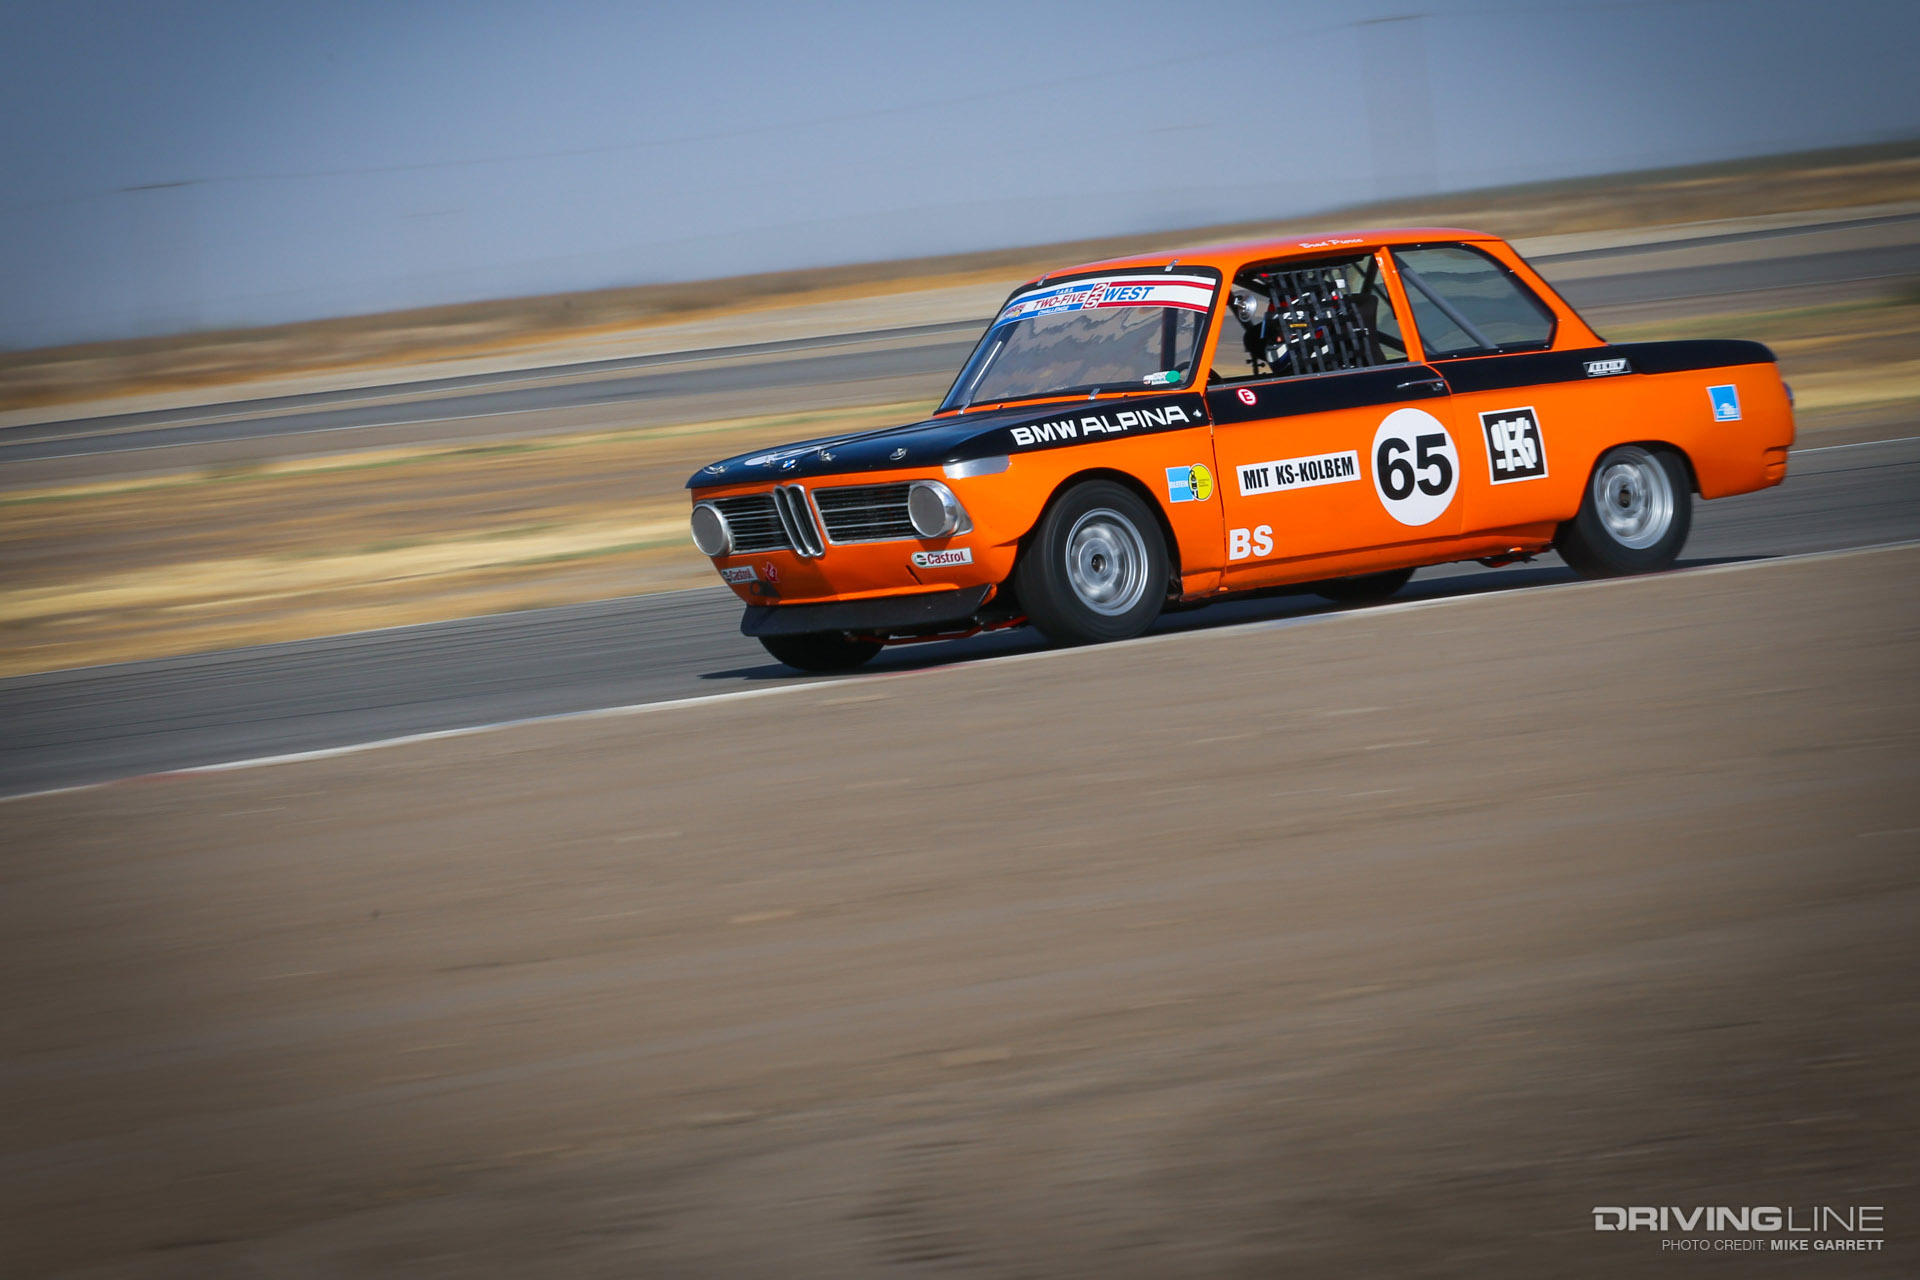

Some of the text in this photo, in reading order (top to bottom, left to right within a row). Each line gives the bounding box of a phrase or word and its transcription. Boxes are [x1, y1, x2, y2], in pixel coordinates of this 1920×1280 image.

[1033, 286, 1155, 310] TWO-FIVE WEST
[1240, 390, 1254, 402] E
[1010, 405, 1190, 446] BMW ALPINA
[1242, 456, 1355, 490] MIT KS-KOLBEM
[1377, 432, 1453, 501] 65
[927, 551, 966, 565] Castrol
[1229, 524, 1274, 561] BS
